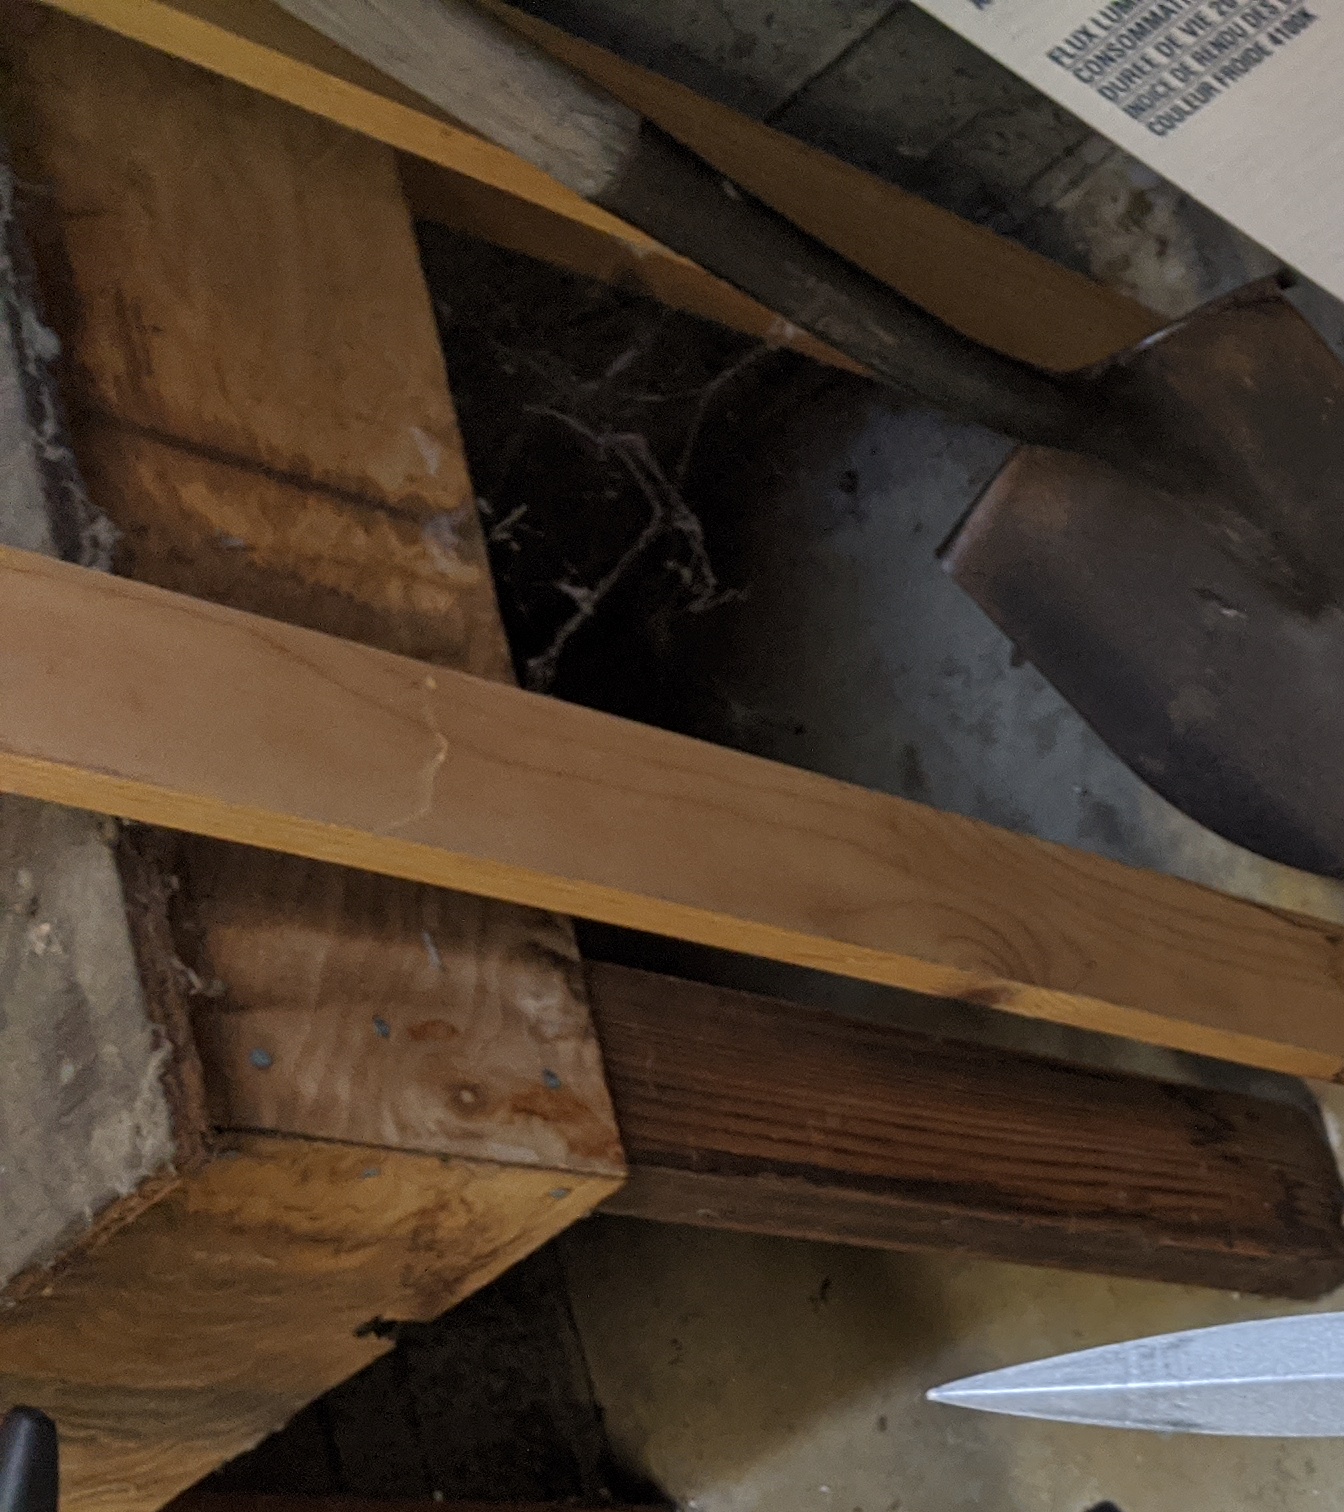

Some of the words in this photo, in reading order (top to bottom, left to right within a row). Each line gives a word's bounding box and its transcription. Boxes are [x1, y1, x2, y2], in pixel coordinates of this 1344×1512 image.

[1046, 24, 1100, 70] FLUX
[1089, 0, 1141, 31] LUM
[1121, 80, 1178, 120] INDICE
[1169, 61, 1201, 83] DE
[1191, 21, 1249, 67] RENDU
[1240, 0, 1280, 29] DES
[1147, 80, 1223, 137] COULEUR
[1211, 41, 1275, 89] FROIDE
[1266, 6, 1318, 46] 4100K
[1153, 34, 1183, 59] DE
[1177, 11, 1213, 38] VIE
